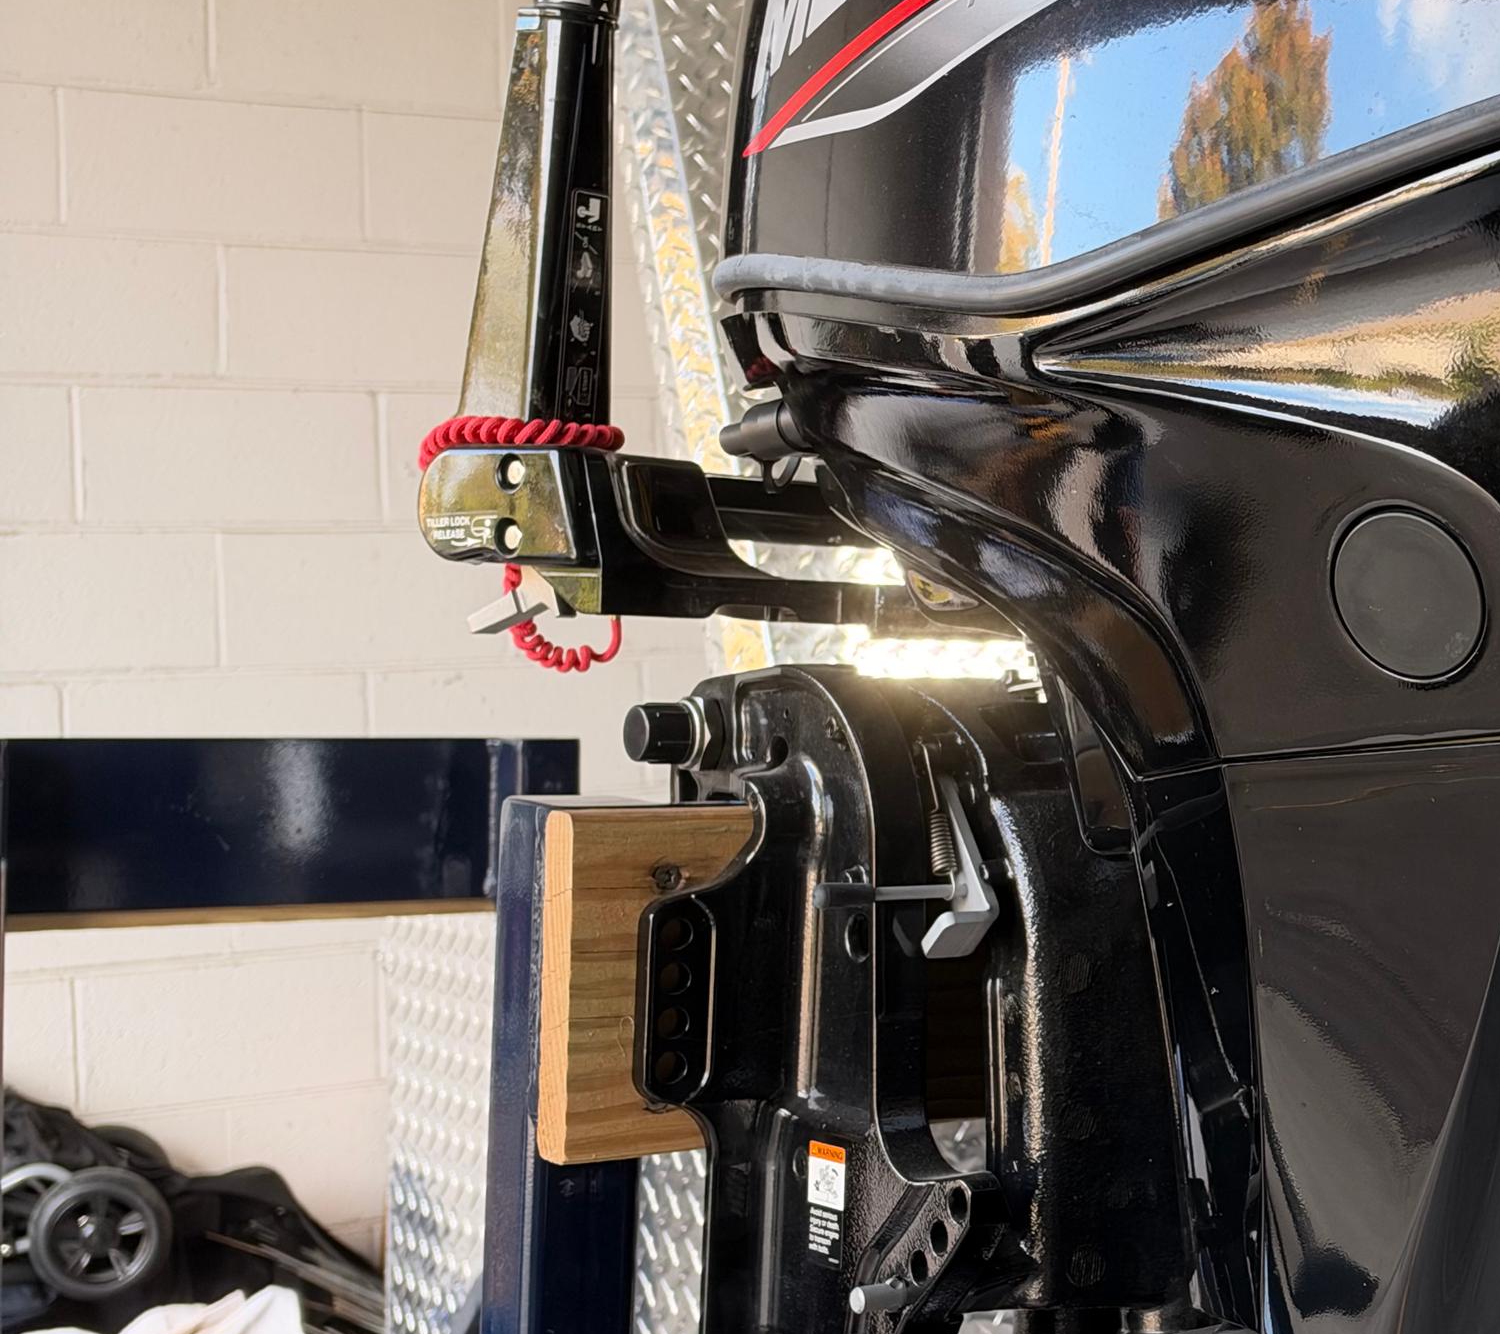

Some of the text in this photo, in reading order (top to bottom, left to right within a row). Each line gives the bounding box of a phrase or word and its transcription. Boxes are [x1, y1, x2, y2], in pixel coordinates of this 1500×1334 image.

[426, 515, 471, 528] TILLER LOCK
[432, 528, 465, 540] RELEASE
